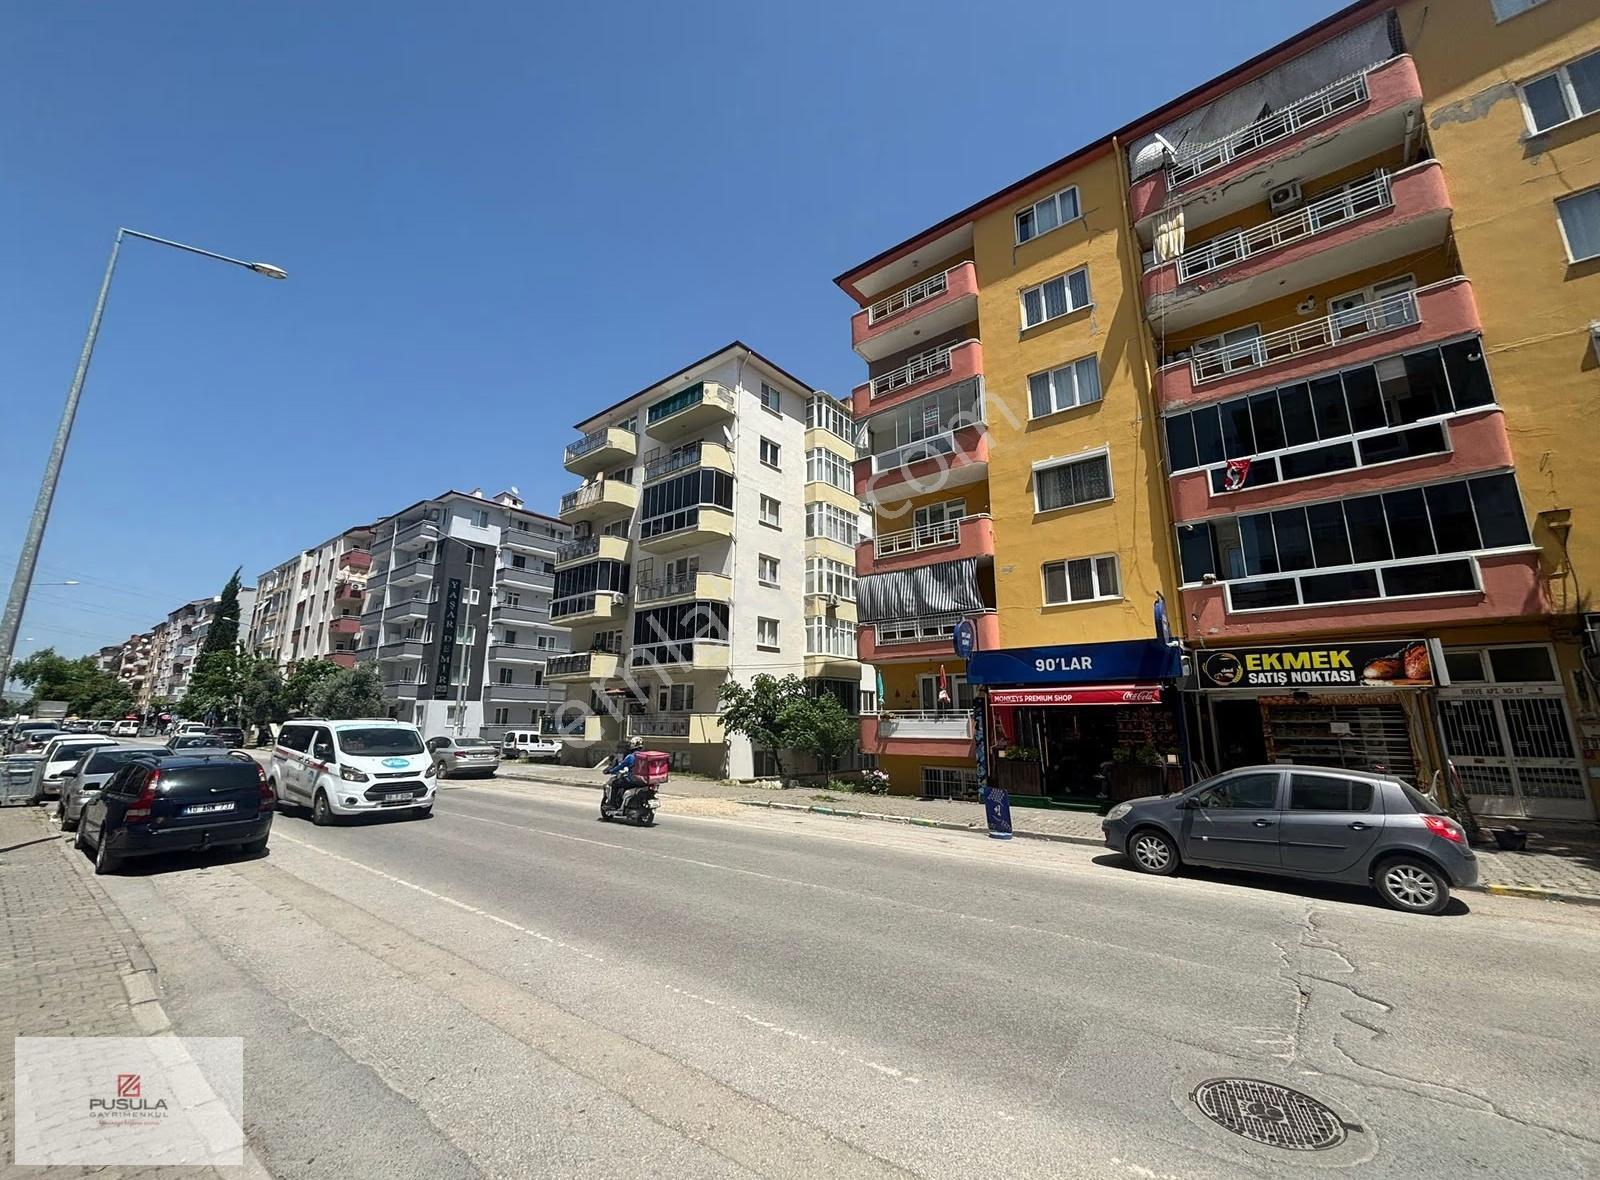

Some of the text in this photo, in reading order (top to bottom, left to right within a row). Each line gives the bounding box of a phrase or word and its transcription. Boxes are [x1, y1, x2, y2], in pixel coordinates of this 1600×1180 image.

[1035, 656, 1092, 672] 90'LAR
[1245, 649, 1353, 671] EKMEK
[1249, 669, 1356, 686] SATIŞ NOKTASI
[994, 695, 1024, 703] MONKEYS
[1054, 694, 1073, 702] SHOP
